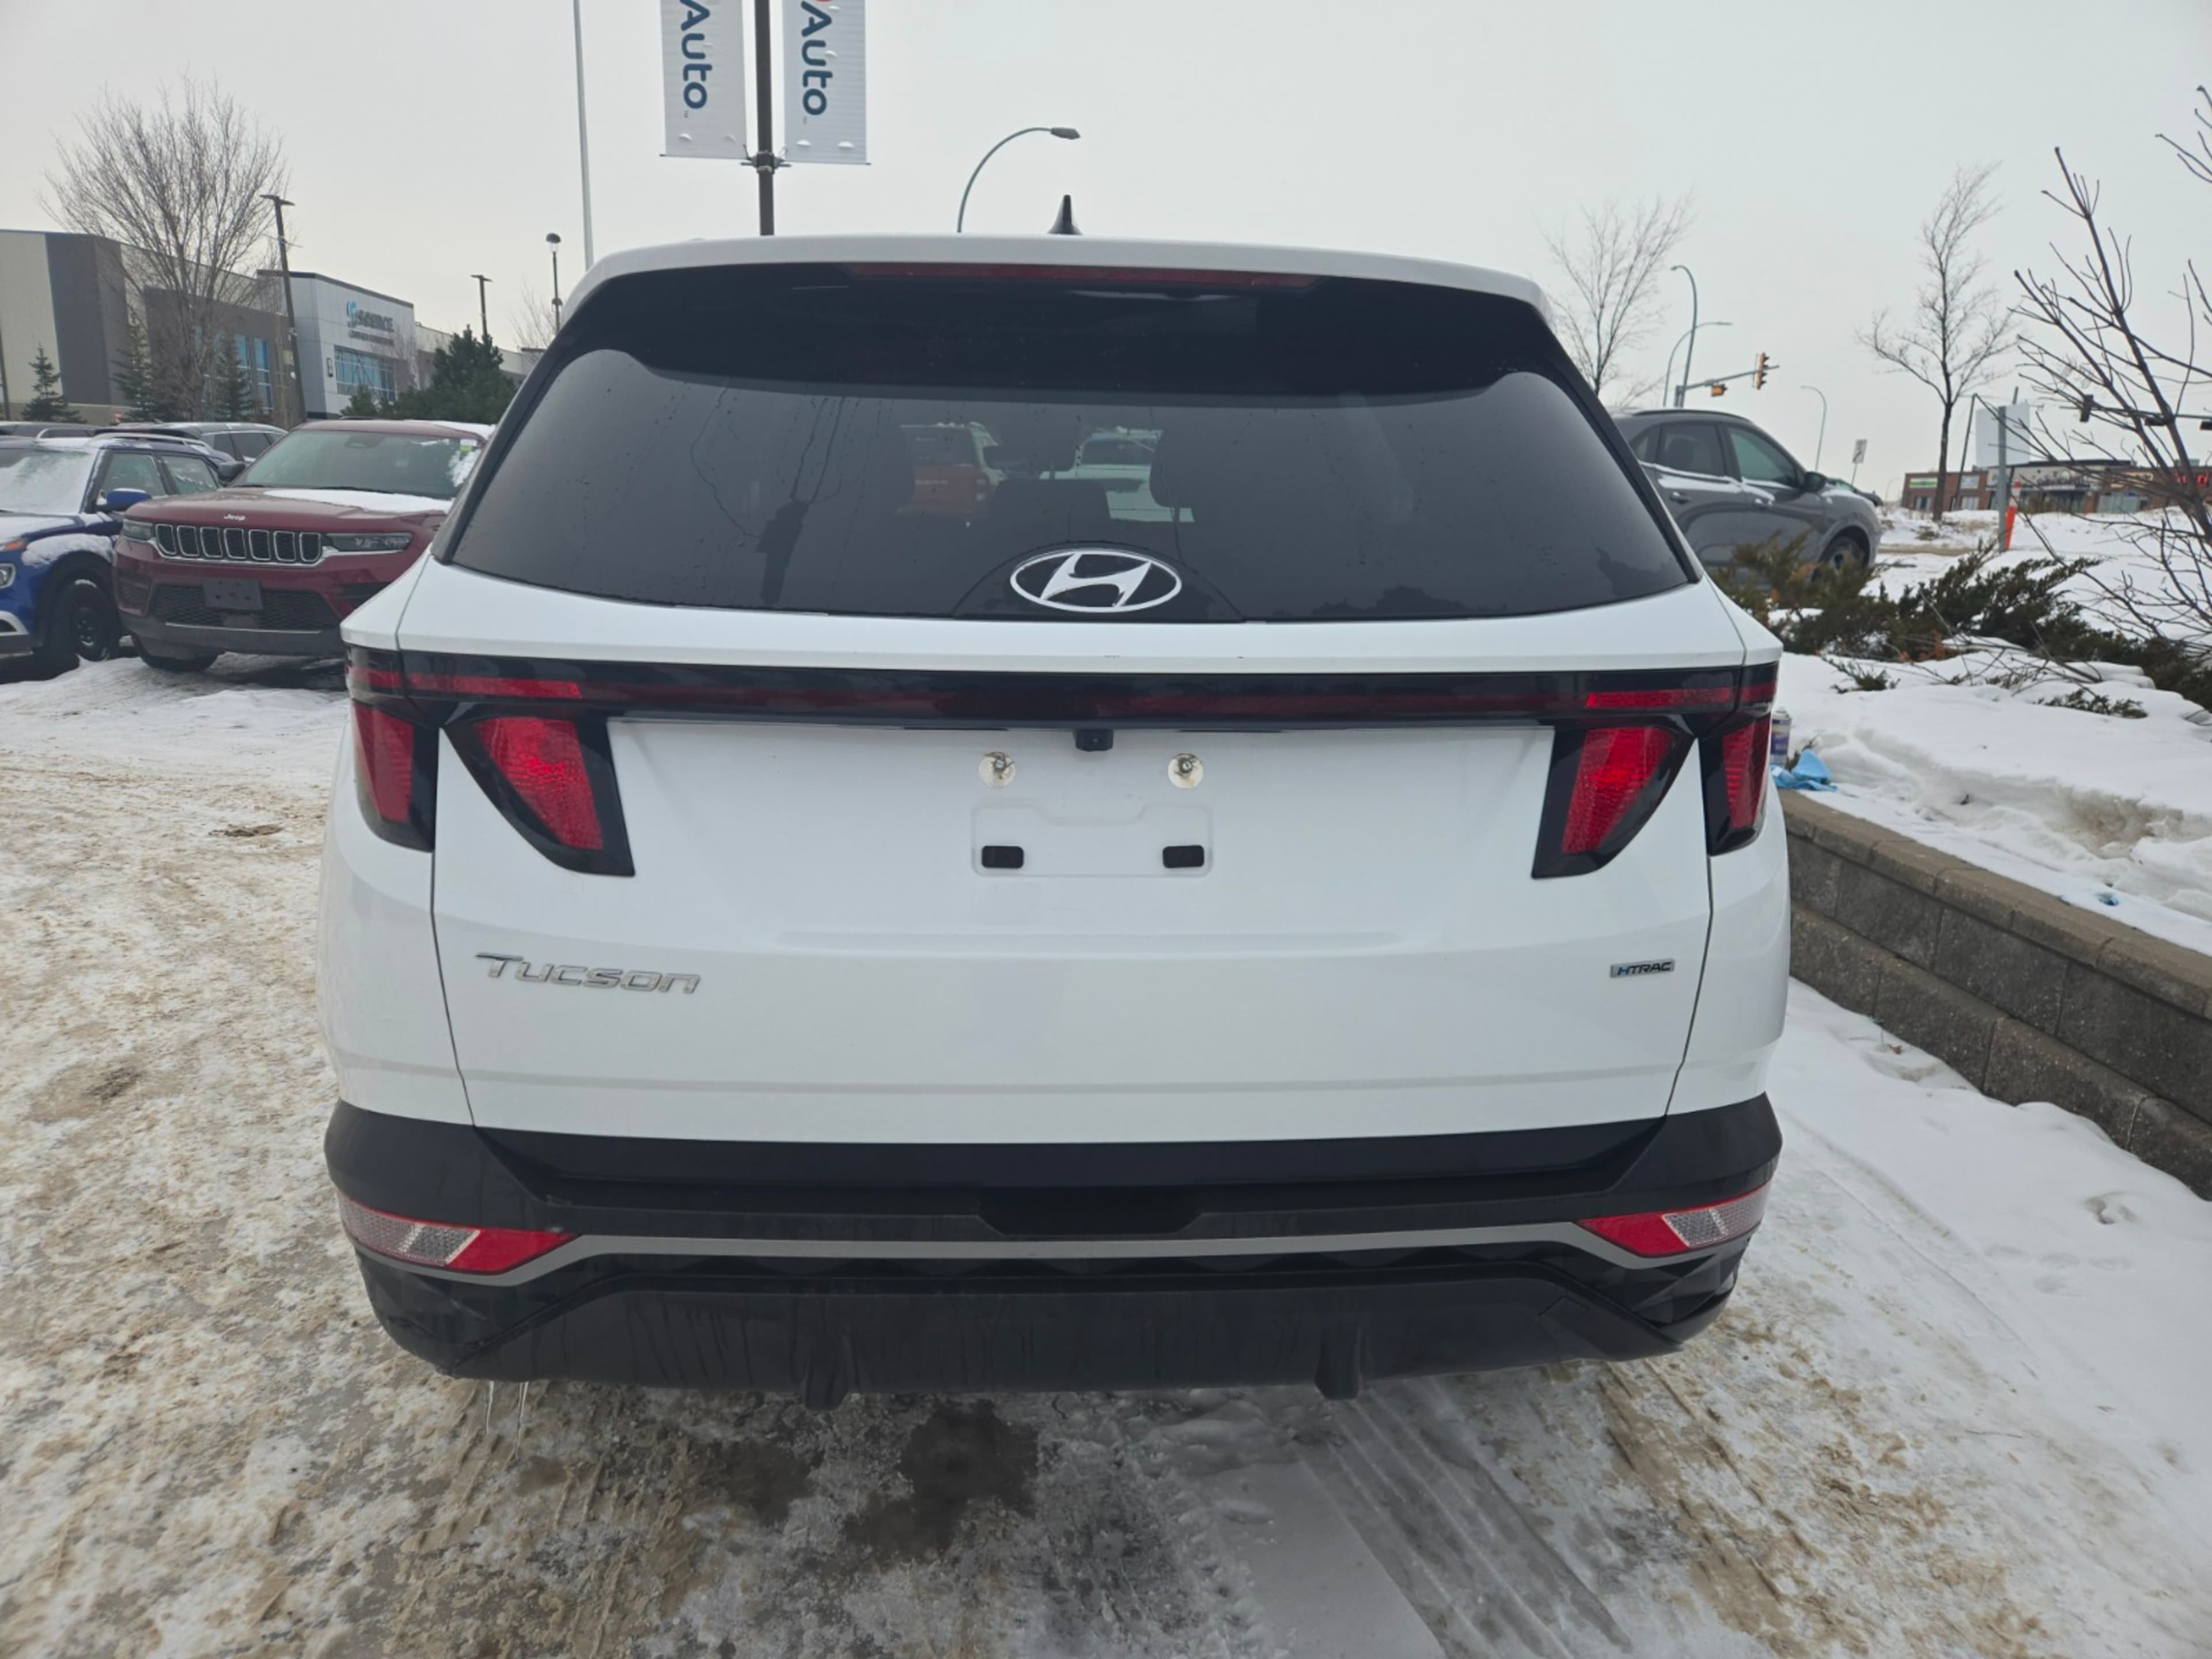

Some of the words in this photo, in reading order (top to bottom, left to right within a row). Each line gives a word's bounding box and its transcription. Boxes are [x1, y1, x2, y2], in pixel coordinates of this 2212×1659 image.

[679, 0, 713, 109] Auto
[800, 1, 833, 116] Auto
[224, 513, 246, 522] Jeep
[475, 952, 701, 995] Tucson
[1617, 961, 1672, 976] HTRAC
